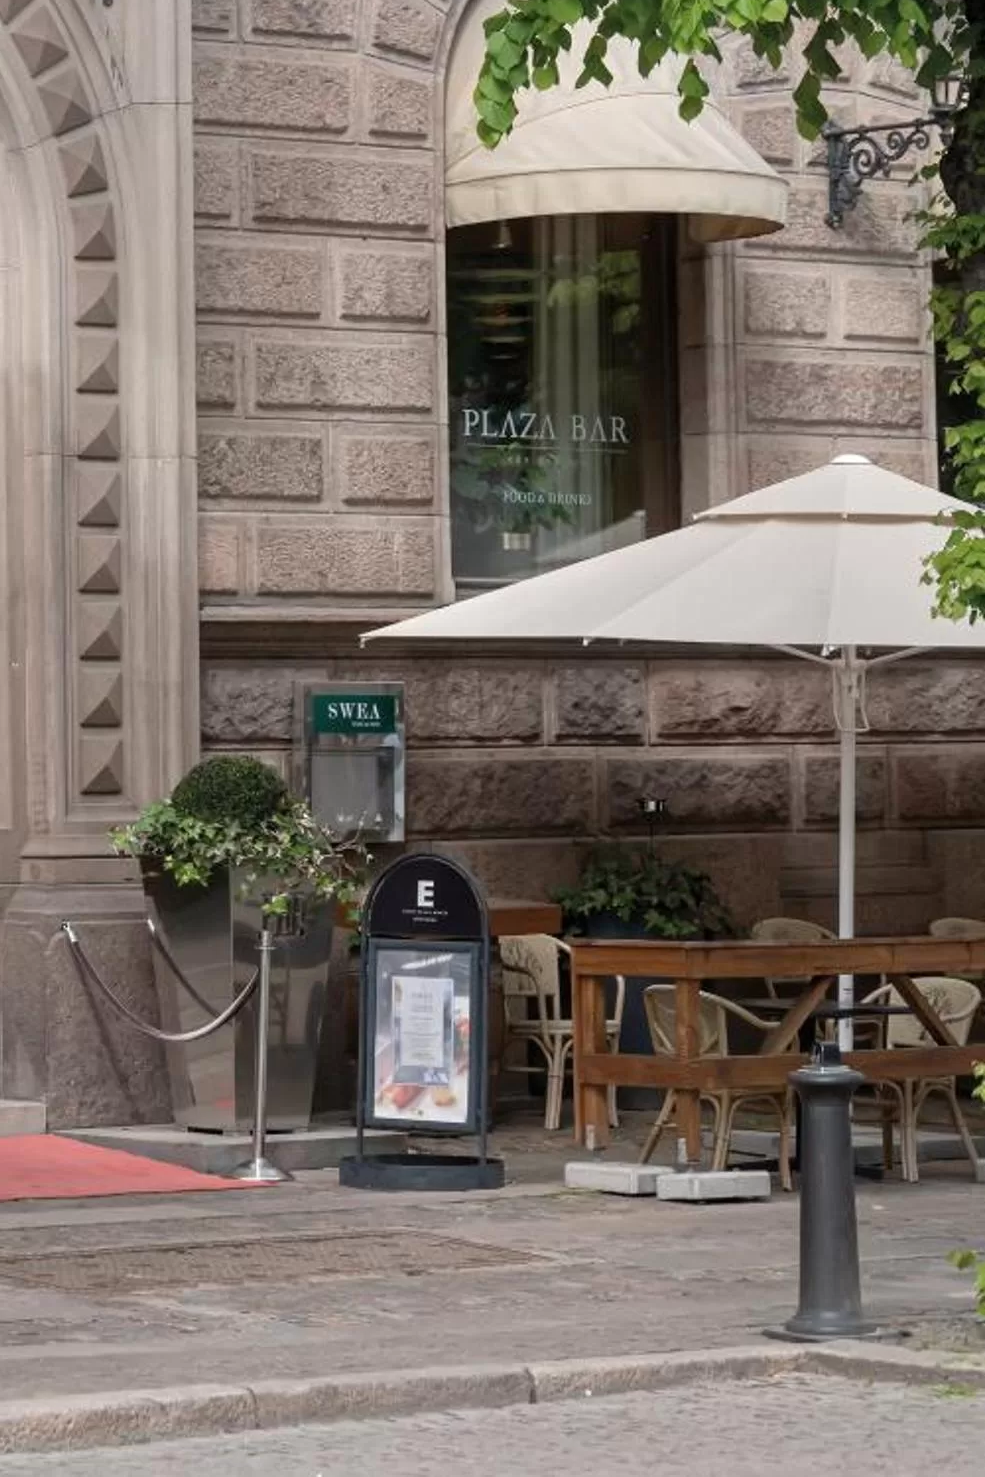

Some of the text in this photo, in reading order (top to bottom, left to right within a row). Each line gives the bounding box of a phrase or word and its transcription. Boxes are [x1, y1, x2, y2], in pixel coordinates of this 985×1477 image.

[462, 409, 630, 444] PLAZA BAR
[503, 490, 536, 503] FOOD
[327, 702, 381, 720] SWEA
[416, 880, 435, 908] E
